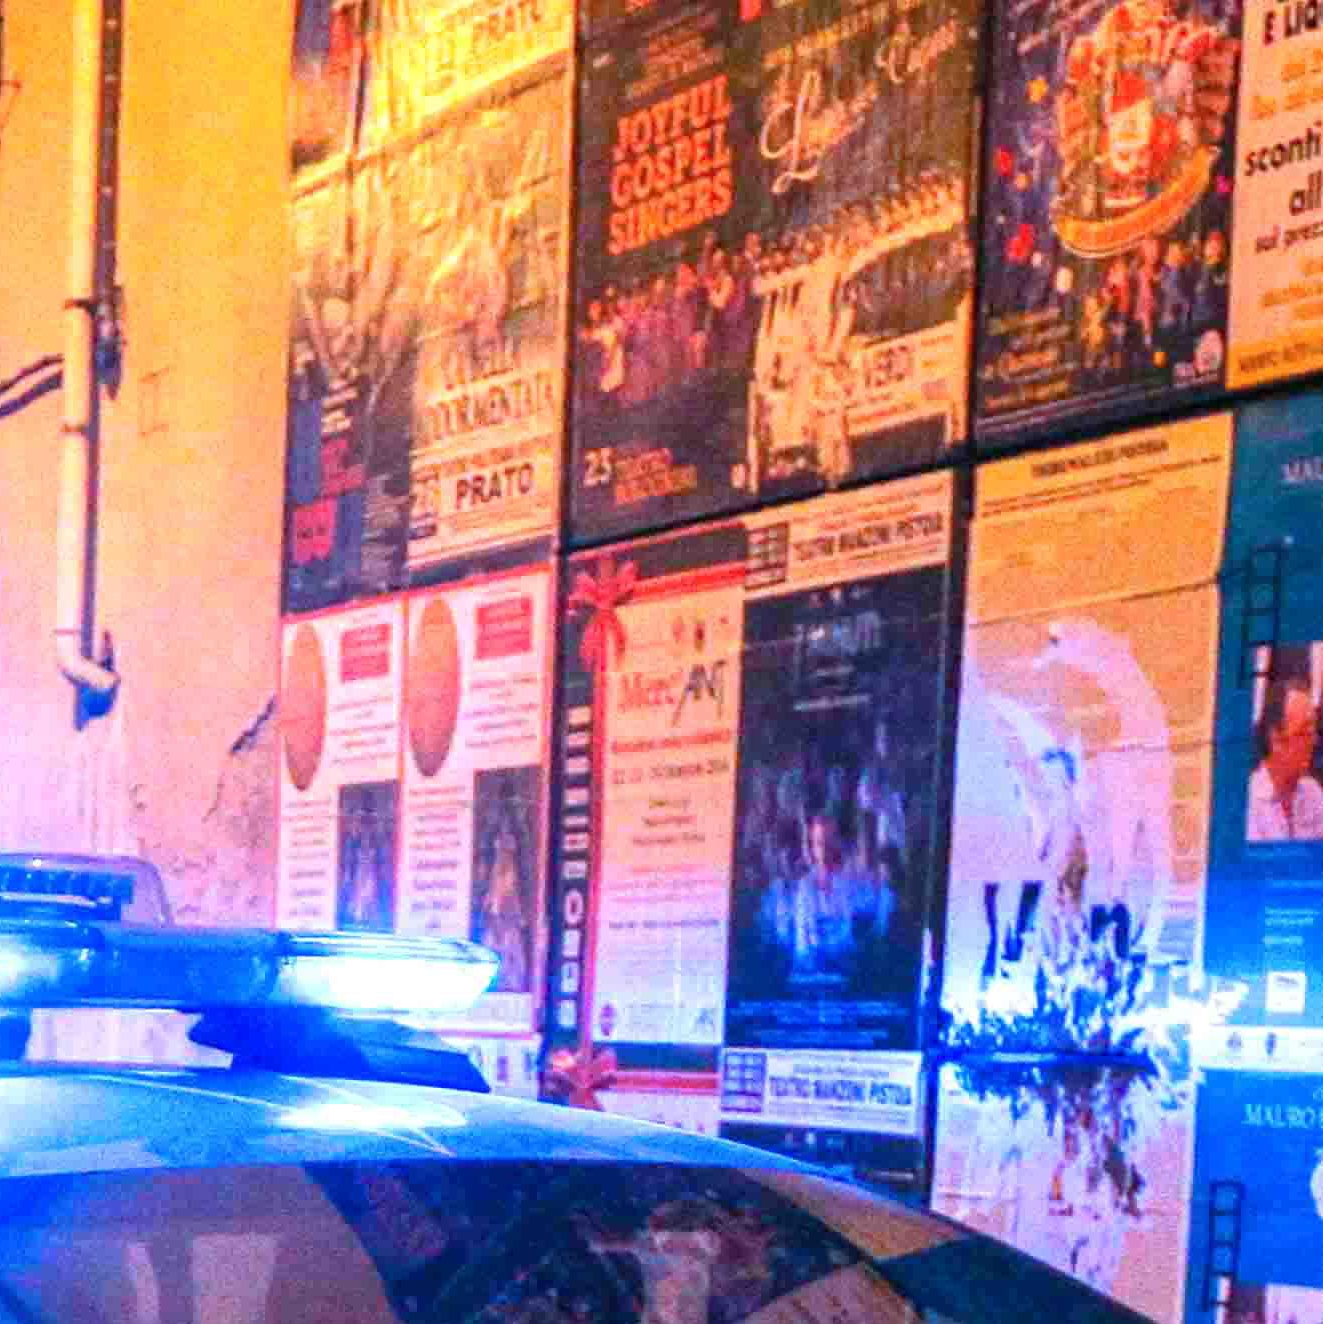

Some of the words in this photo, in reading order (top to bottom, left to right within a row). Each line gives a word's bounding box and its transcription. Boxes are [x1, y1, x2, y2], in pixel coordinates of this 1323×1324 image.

[614, 73, 730, 162] JOYFUL
[610, 122, 731, 208] GOSPEL
[605, 168, 733, 257] SINGERS
[455, 462, 535, 512] PRATO
